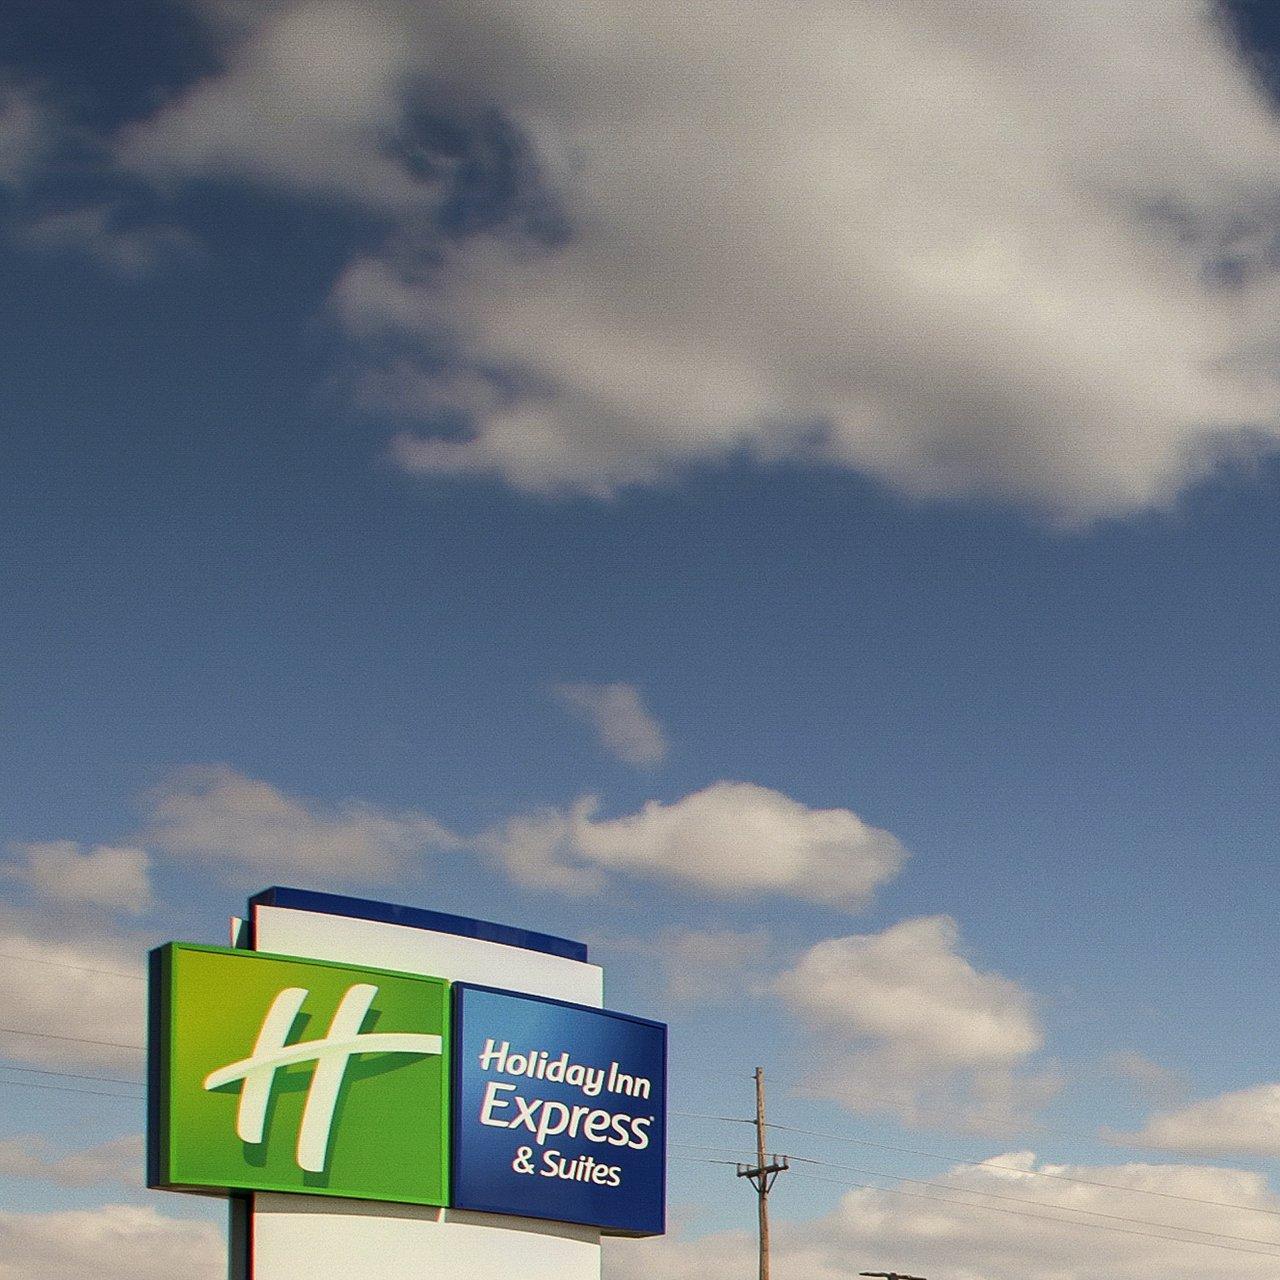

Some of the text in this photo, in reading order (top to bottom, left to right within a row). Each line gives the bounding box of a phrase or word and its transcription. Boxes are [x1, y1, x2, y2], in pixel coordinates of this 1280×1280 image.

[478, 1038, 651, 1100] Holiday Inn
[479, 1081, 652, 1150] Express
[512, 1146, 622, 1187] & Suites
